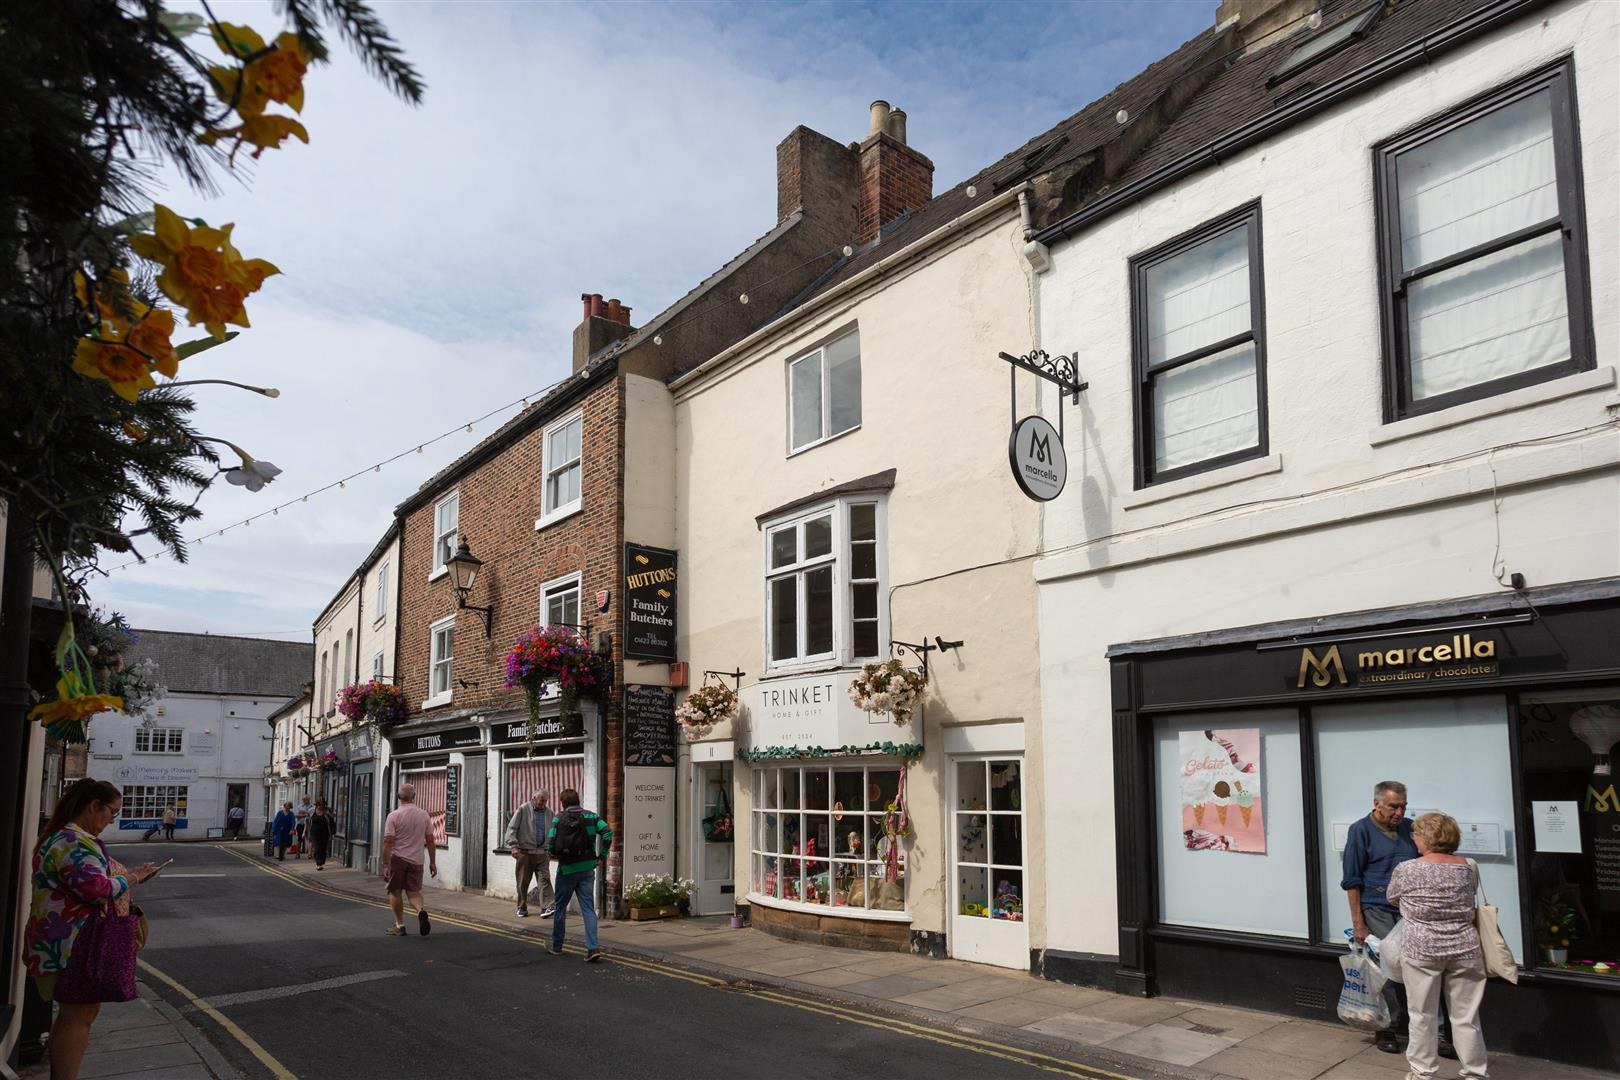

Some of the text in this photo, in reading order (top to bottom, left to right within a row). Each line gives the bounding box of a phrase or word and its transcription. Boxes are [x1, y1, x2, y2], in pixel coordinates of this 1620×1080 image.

[1025, 464, 1058, 482] marcella
[627, 567, 676, 590] HUTTONS
[633, 598, 669, 616] Family
[630, 611, 673, 627] Butchers
[1358, 633, 1496, 668] marcella
[1359, 664, 1497, 683] extraordinary chocolates
[762, 685, 833, 708] TRINKET
[805, 709, 822, 717] GIFT
[417, 735, 441, 749] HUTTONS
[1184, 755, 1225, 776] Gelato
[635, 784, 665, 792] WELCOME
[656, 832, 661, 840] &
[634, 854, 665, 862] BOUTIQUE
